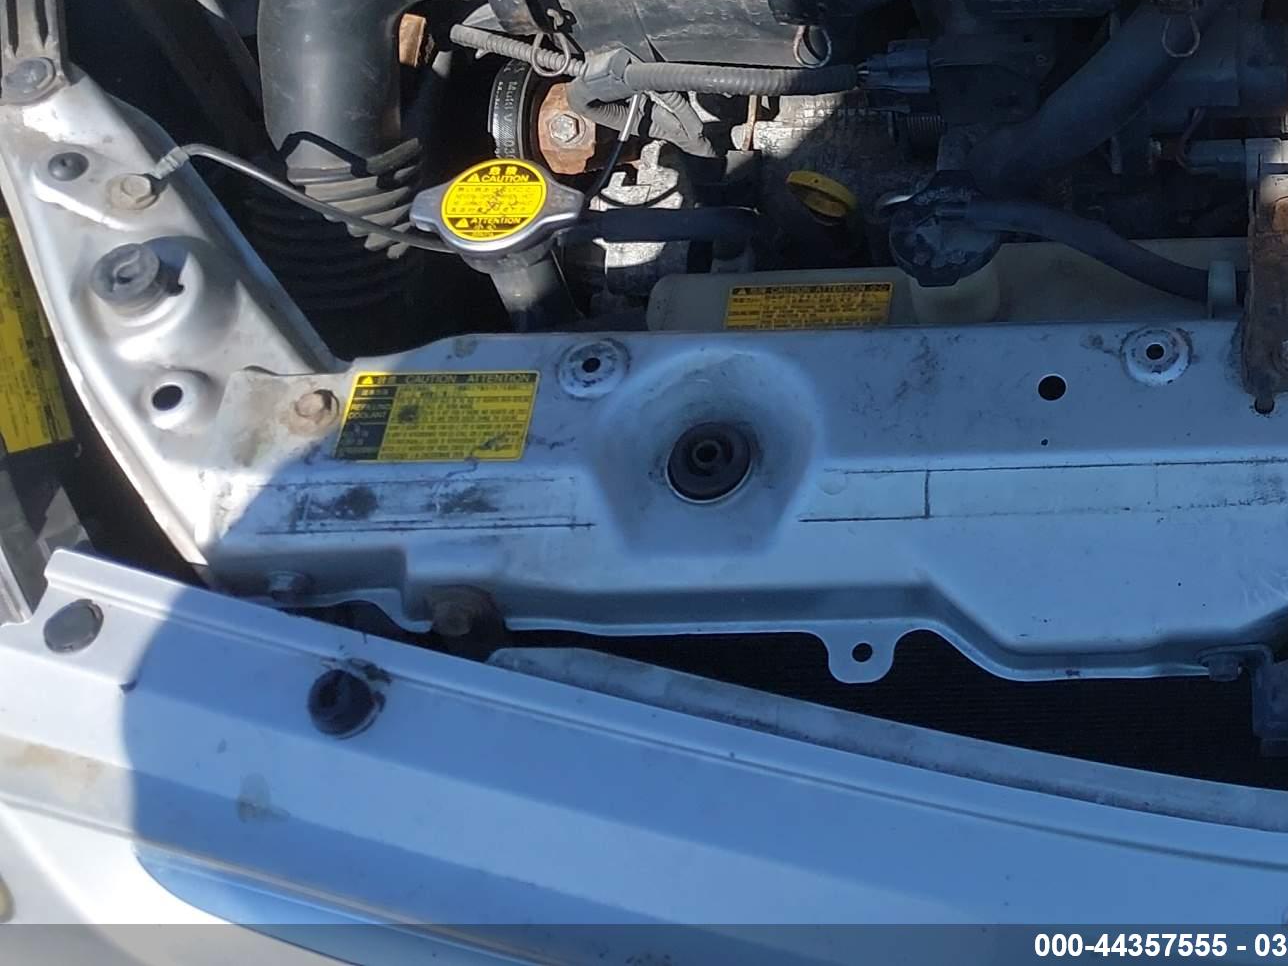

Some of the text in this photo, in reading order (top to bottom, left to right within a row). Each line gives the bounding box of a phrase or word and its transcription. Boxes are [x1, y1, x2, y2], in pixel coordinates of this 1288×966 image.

[481, 174, 530, 183] CAUTION
[469, 217, 522, 225] ATTENTION
[405, 375, 457, 384] CAUTION
[466, 375, 530, 383] ATTENTION
